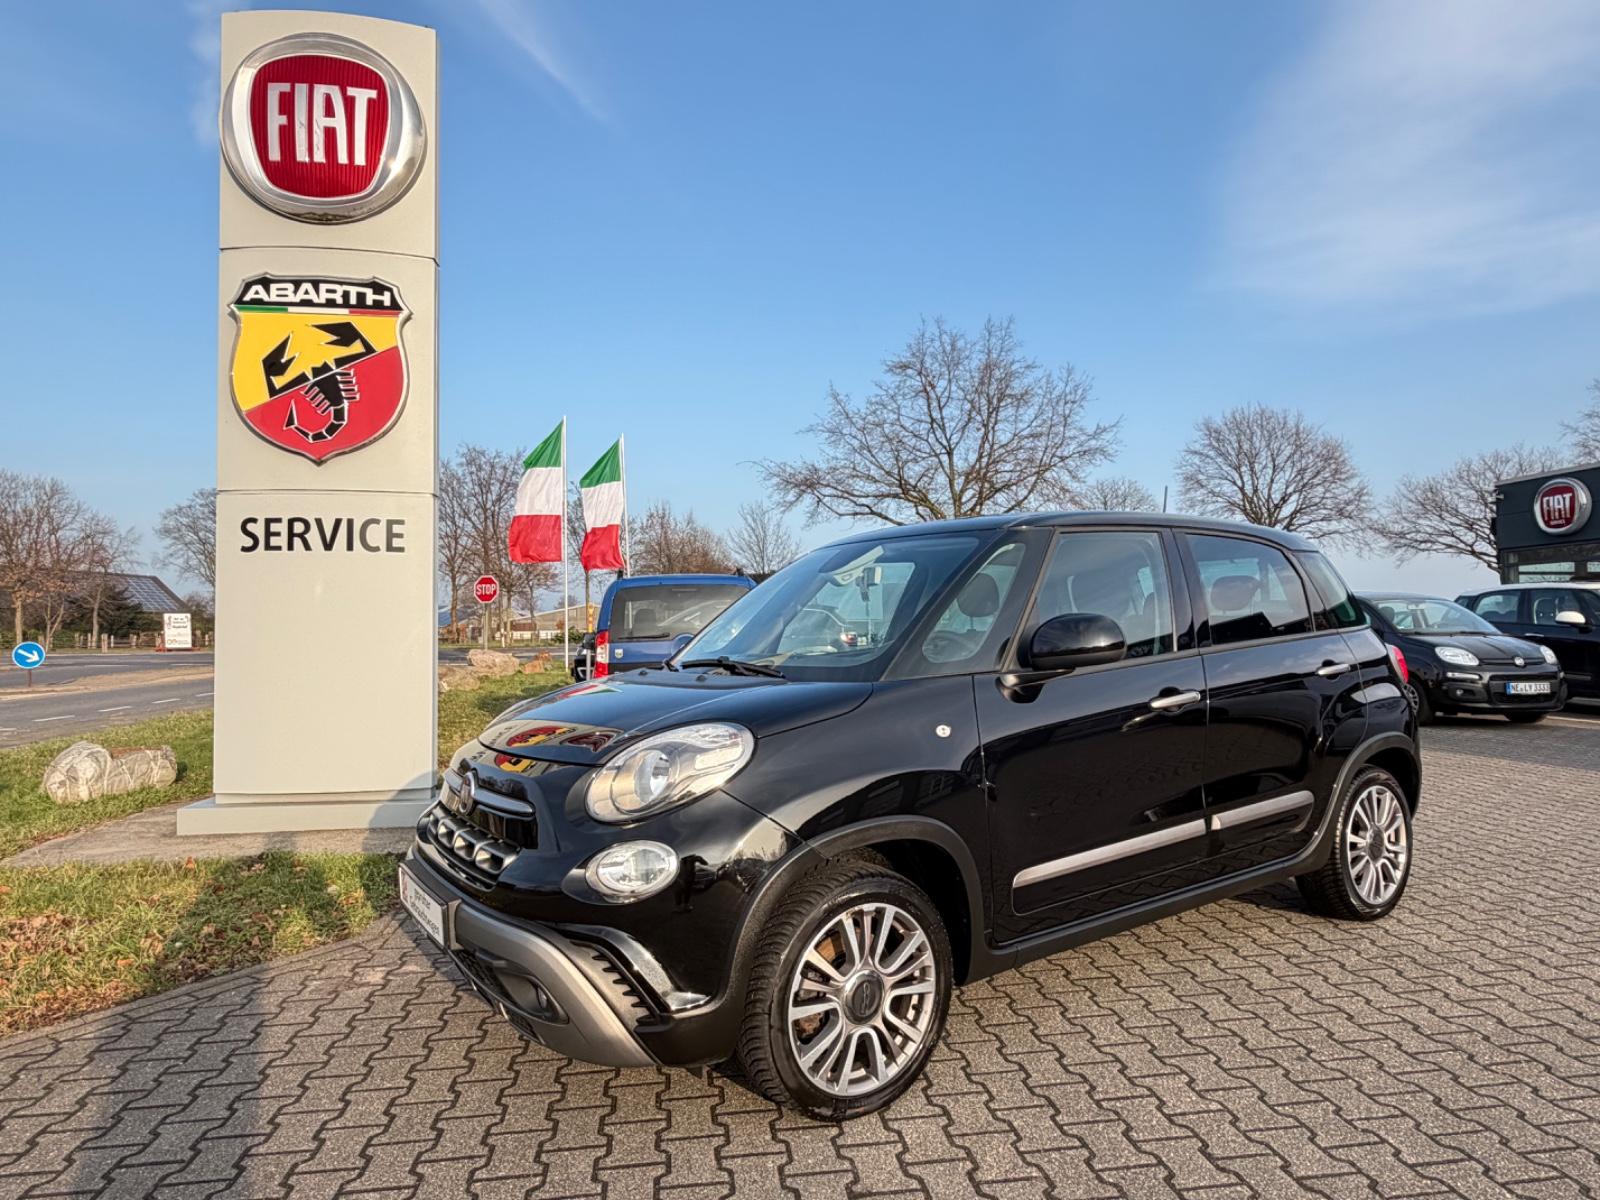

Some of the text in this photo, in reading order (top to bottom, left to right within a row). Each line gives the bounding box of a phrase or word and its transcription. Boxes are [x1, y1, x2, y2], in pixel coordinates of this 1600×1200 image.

[267, 82, 377, 166] FIAT
[243, 282, 391, 306] ABARTH
[1542, 492, 1573, 521] FIAT
[240, 517, 406, 553] SERVICE
[476, 583, 496, 595] STOP
